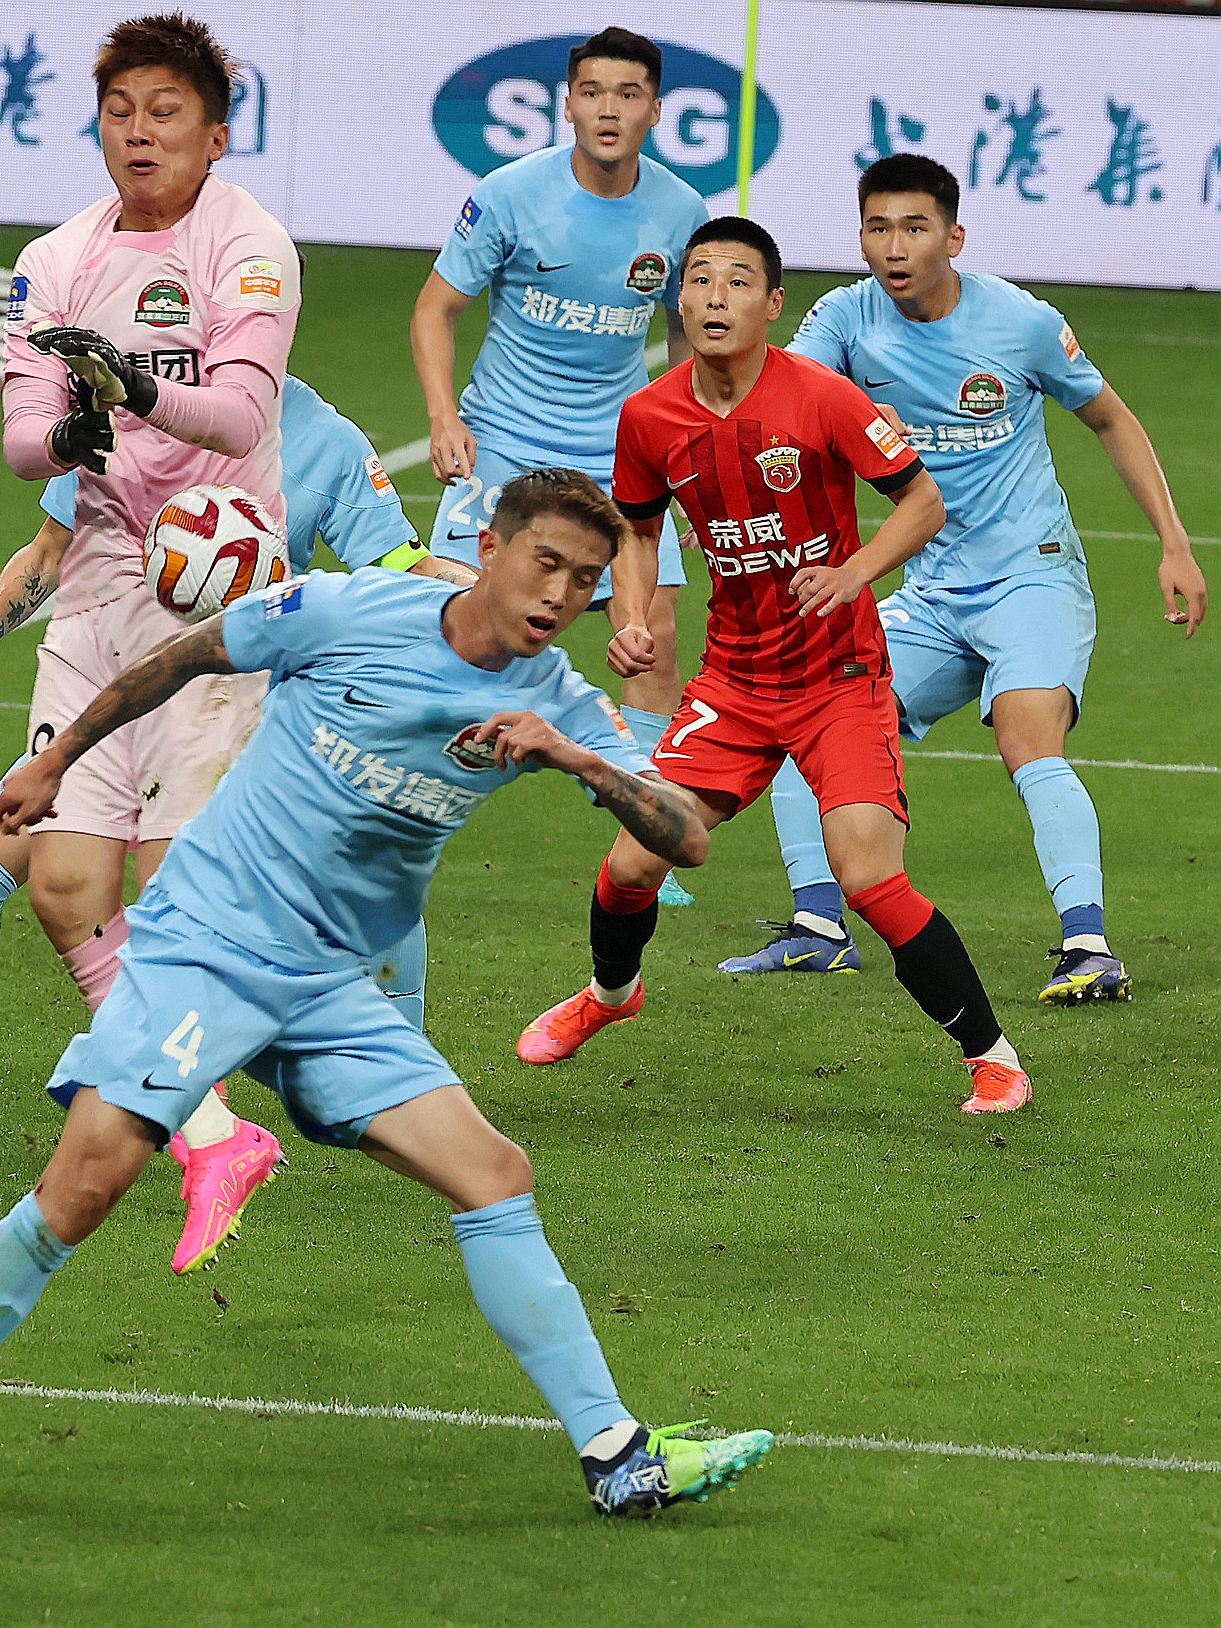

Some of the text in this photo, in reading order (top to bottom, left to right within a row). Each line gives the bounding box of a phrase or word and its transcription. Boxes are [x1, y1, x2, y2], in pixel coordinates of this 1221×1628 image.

[853, 86, 1221, 208] 上港集
[521, 285, 657, 337] 郑发集团
[707, 512, 787, 549] 荣威
[672, 699, 719, 748] 7
[161, 1009, 205, 1079] 4
